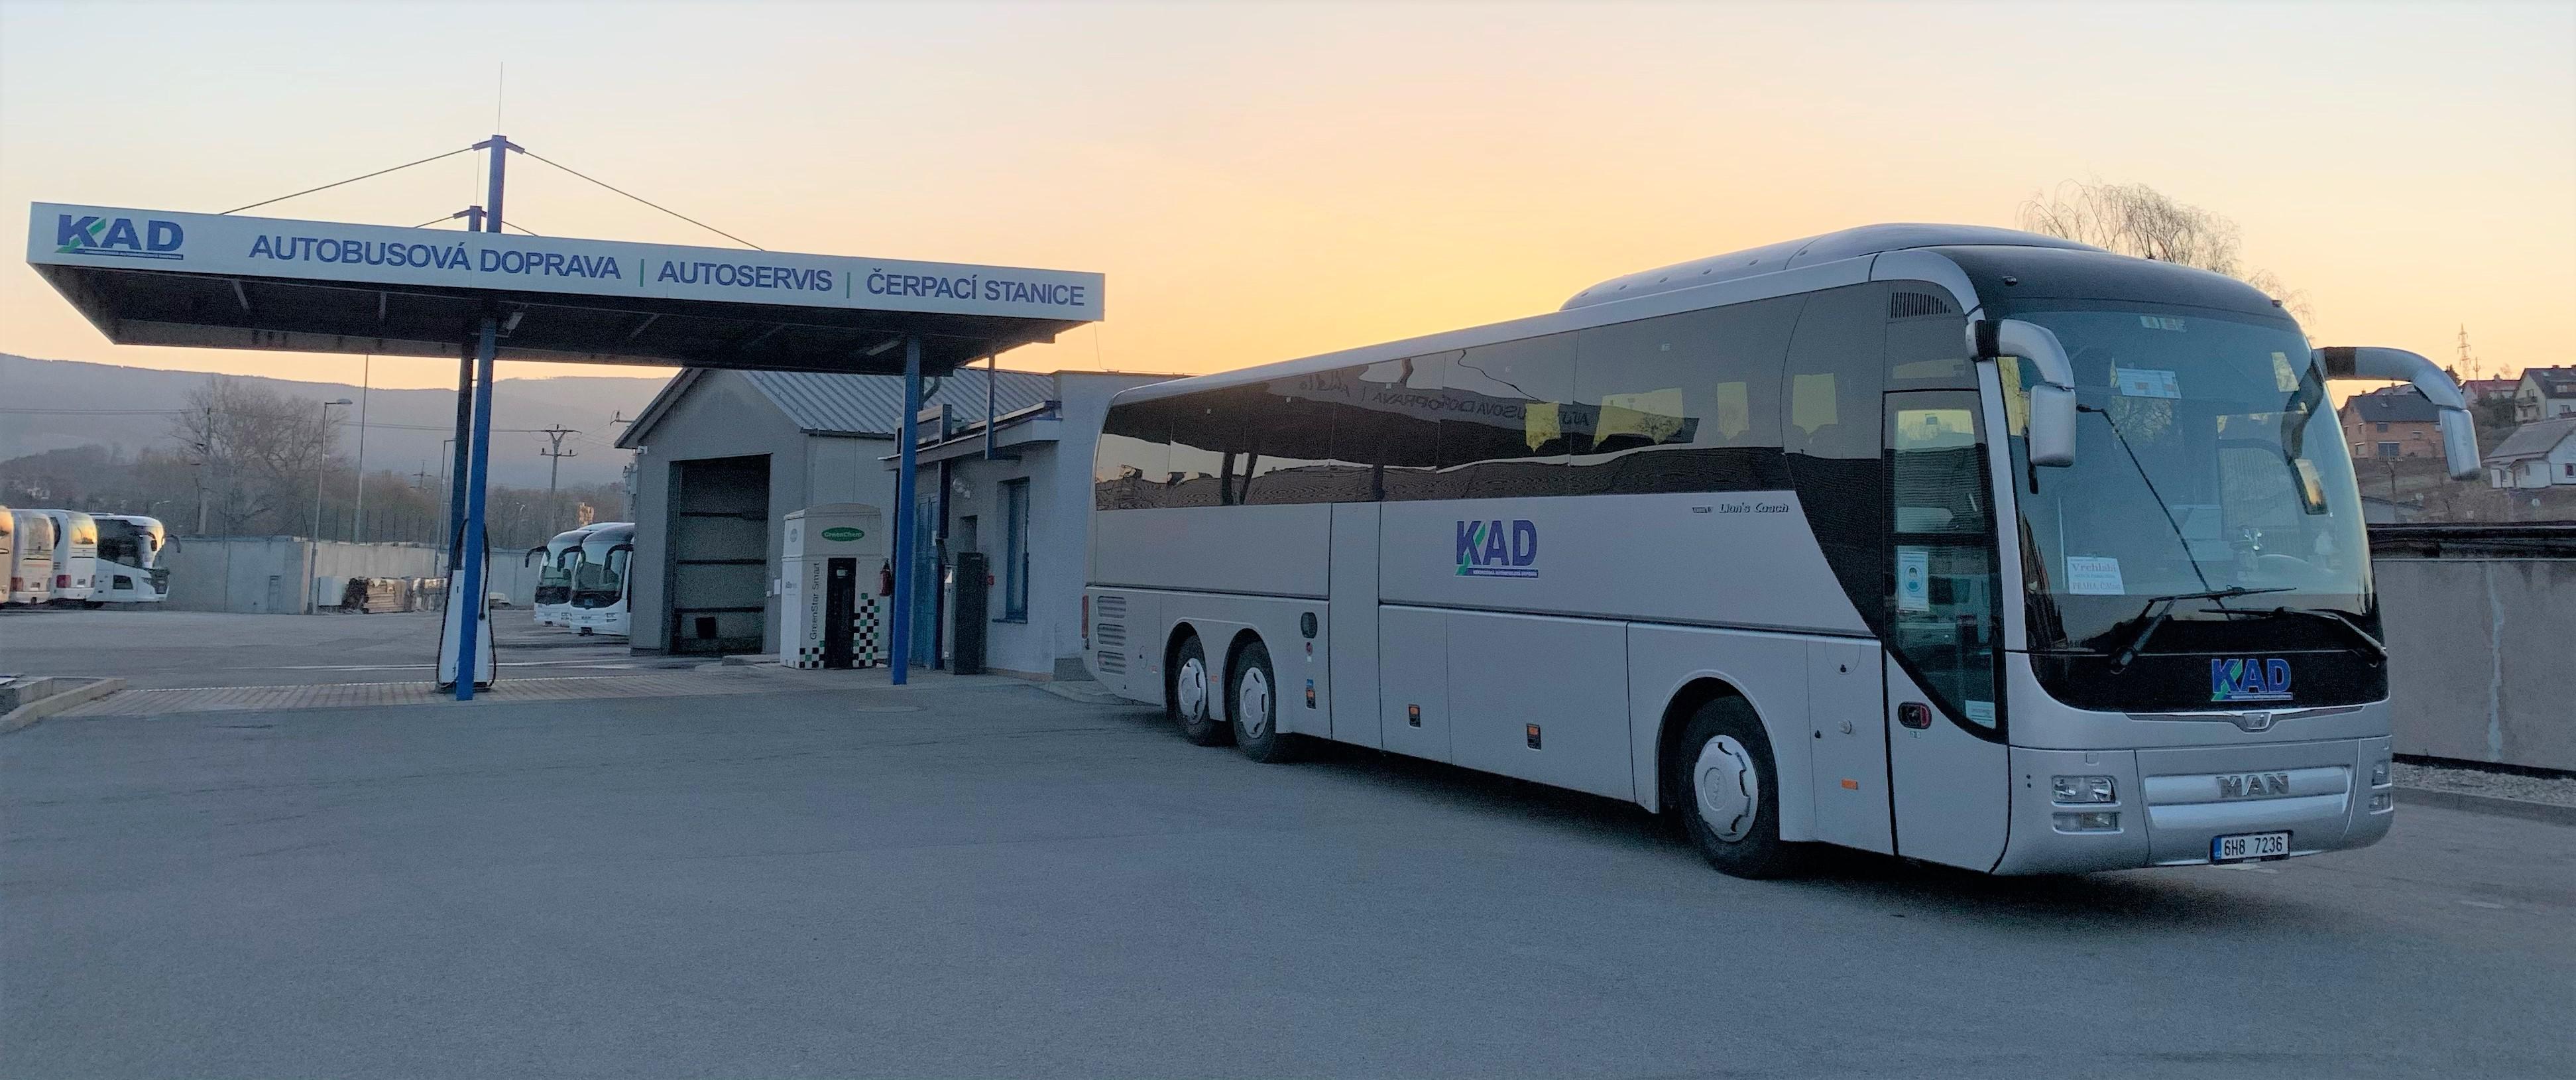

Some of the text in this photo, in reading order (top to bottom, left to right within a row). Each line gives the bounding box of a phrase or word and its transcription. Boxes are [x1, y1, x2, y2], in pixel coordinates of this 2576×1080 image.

[57, 213, 184, 252] KAD
[249, 235, 1084, 306] AUTOBUSOVÁ DOPRAVA AUTOSERVIS ČERPACÍ STANICE
[1755, 503, 1789, 513] Coach
[1456, 520, 1538, 566] KAD
[810, 562, 821, 640] GreenStar Smart
[2211, 658, 2292, 693] KAD
[2215, 772, 2289, 798] MAN
[2224, 836, 2283, 857] 6H8 7236
